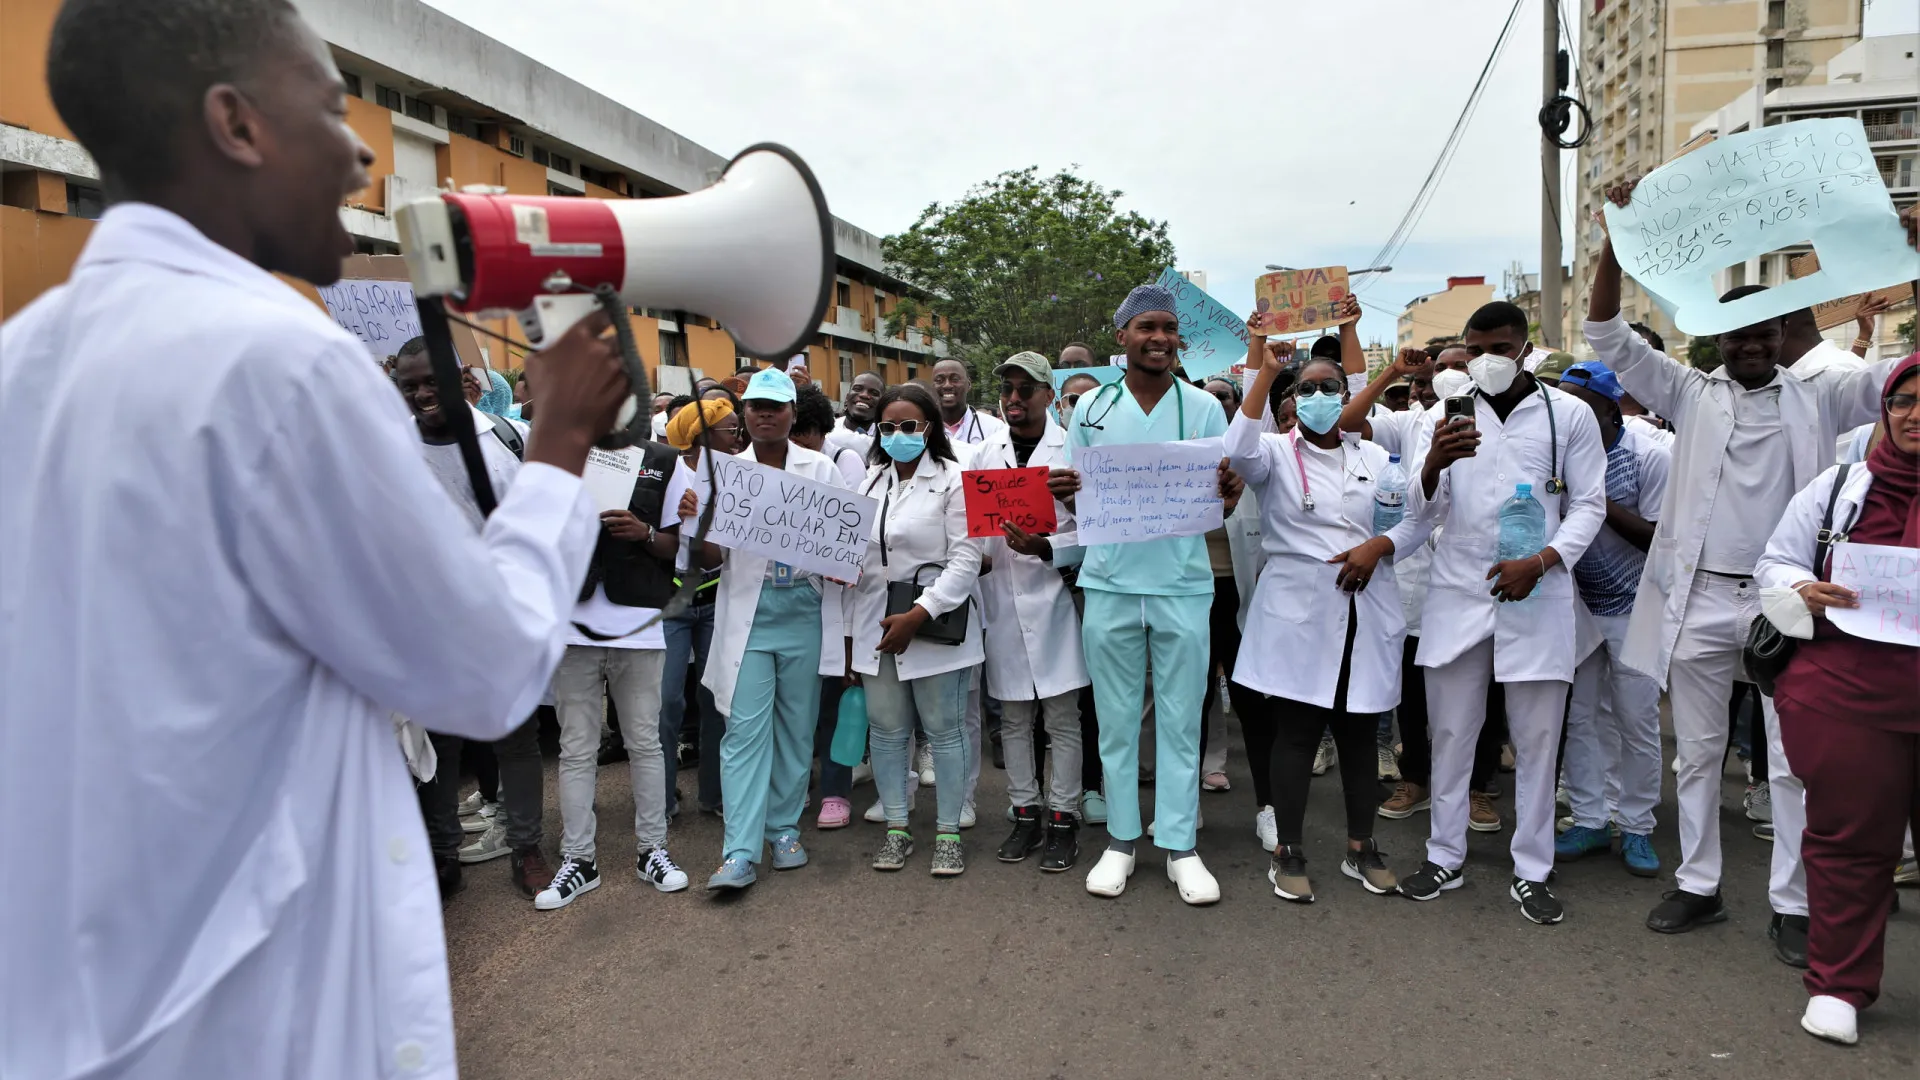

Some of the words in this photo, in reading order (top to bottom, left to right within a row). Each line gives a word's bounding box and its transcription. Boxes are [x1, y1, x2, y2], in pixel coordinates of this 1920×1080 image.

[1705, 132, 1816, 176] MATEM
[1834, 132, 1854, 147] O
[1640, 178, 1748, 247] NOSSO
[1760, 152, 1863, 182] POVO
[1639, 232, 1732, 280] TODOS
[1160, 271, 1189, 301] NÃO
[702, 460, 764, 497] NÃO
[780, 481, 861, 528] VAMOS
[996, 493, 1030, 509] Para
[764, 505, 825, 538] CALAR
[780, 533, 791, 549] O
[796, 534, 833, 558] POVO
